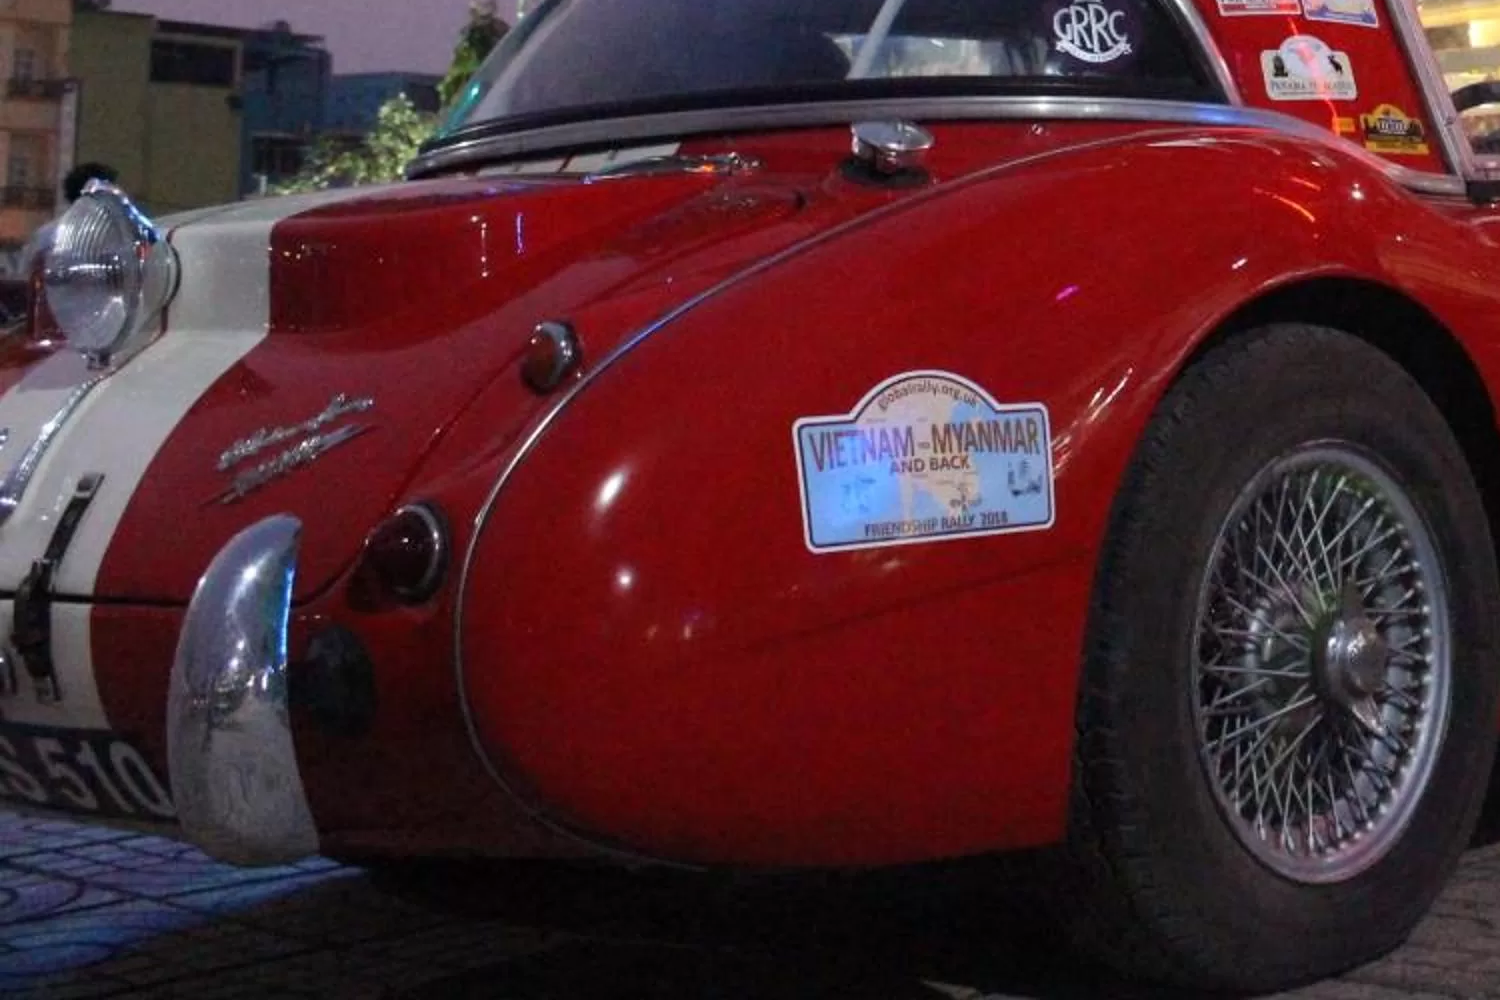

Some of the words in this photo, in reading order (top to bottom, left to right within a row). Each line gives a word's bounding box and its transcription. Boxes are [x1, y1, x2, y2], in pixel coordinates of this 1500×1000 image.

[809, 426, 915, 473] VIETNAM
[931, 418, 1041, 455] MYANMAR
[889, 457, 925, 475] AND
[930, 455, 970, 471] BACK
[941, 512, 975, 530] RALLY
